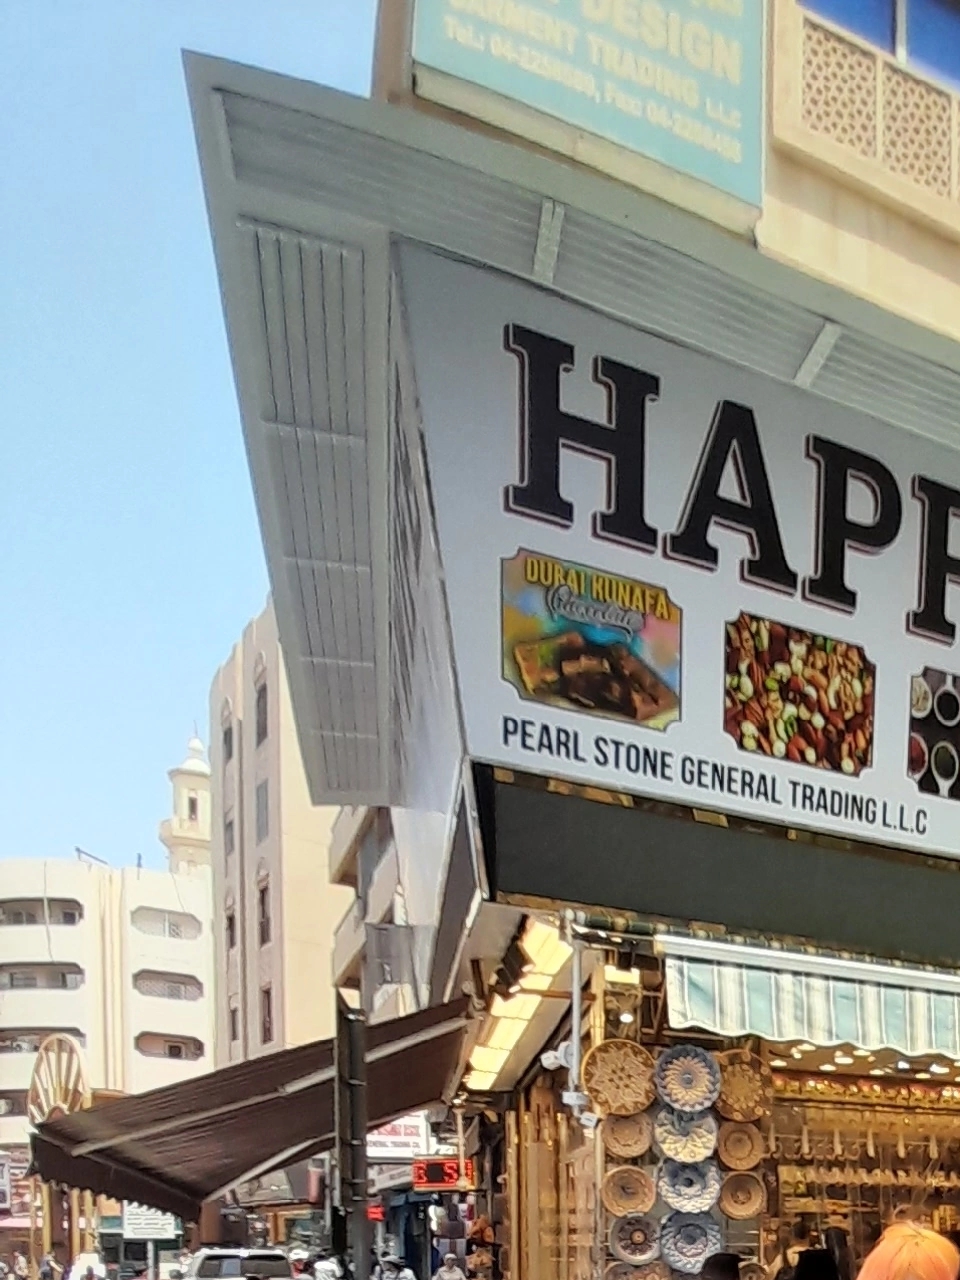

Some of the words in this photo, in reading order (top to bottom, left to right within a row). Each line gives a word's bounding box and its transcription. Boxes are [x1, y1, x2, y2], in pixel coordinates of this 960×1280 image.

[592, 573, 672, 621] KUNAFA
[502, 715, 587, 763] PEARL
[593, 735, 674, 782] STONE
[680, 755, 783, 806] GENERAL
[788, 779, 877, 825] TRADING
[882, 801, 928, 836] L.L.C
